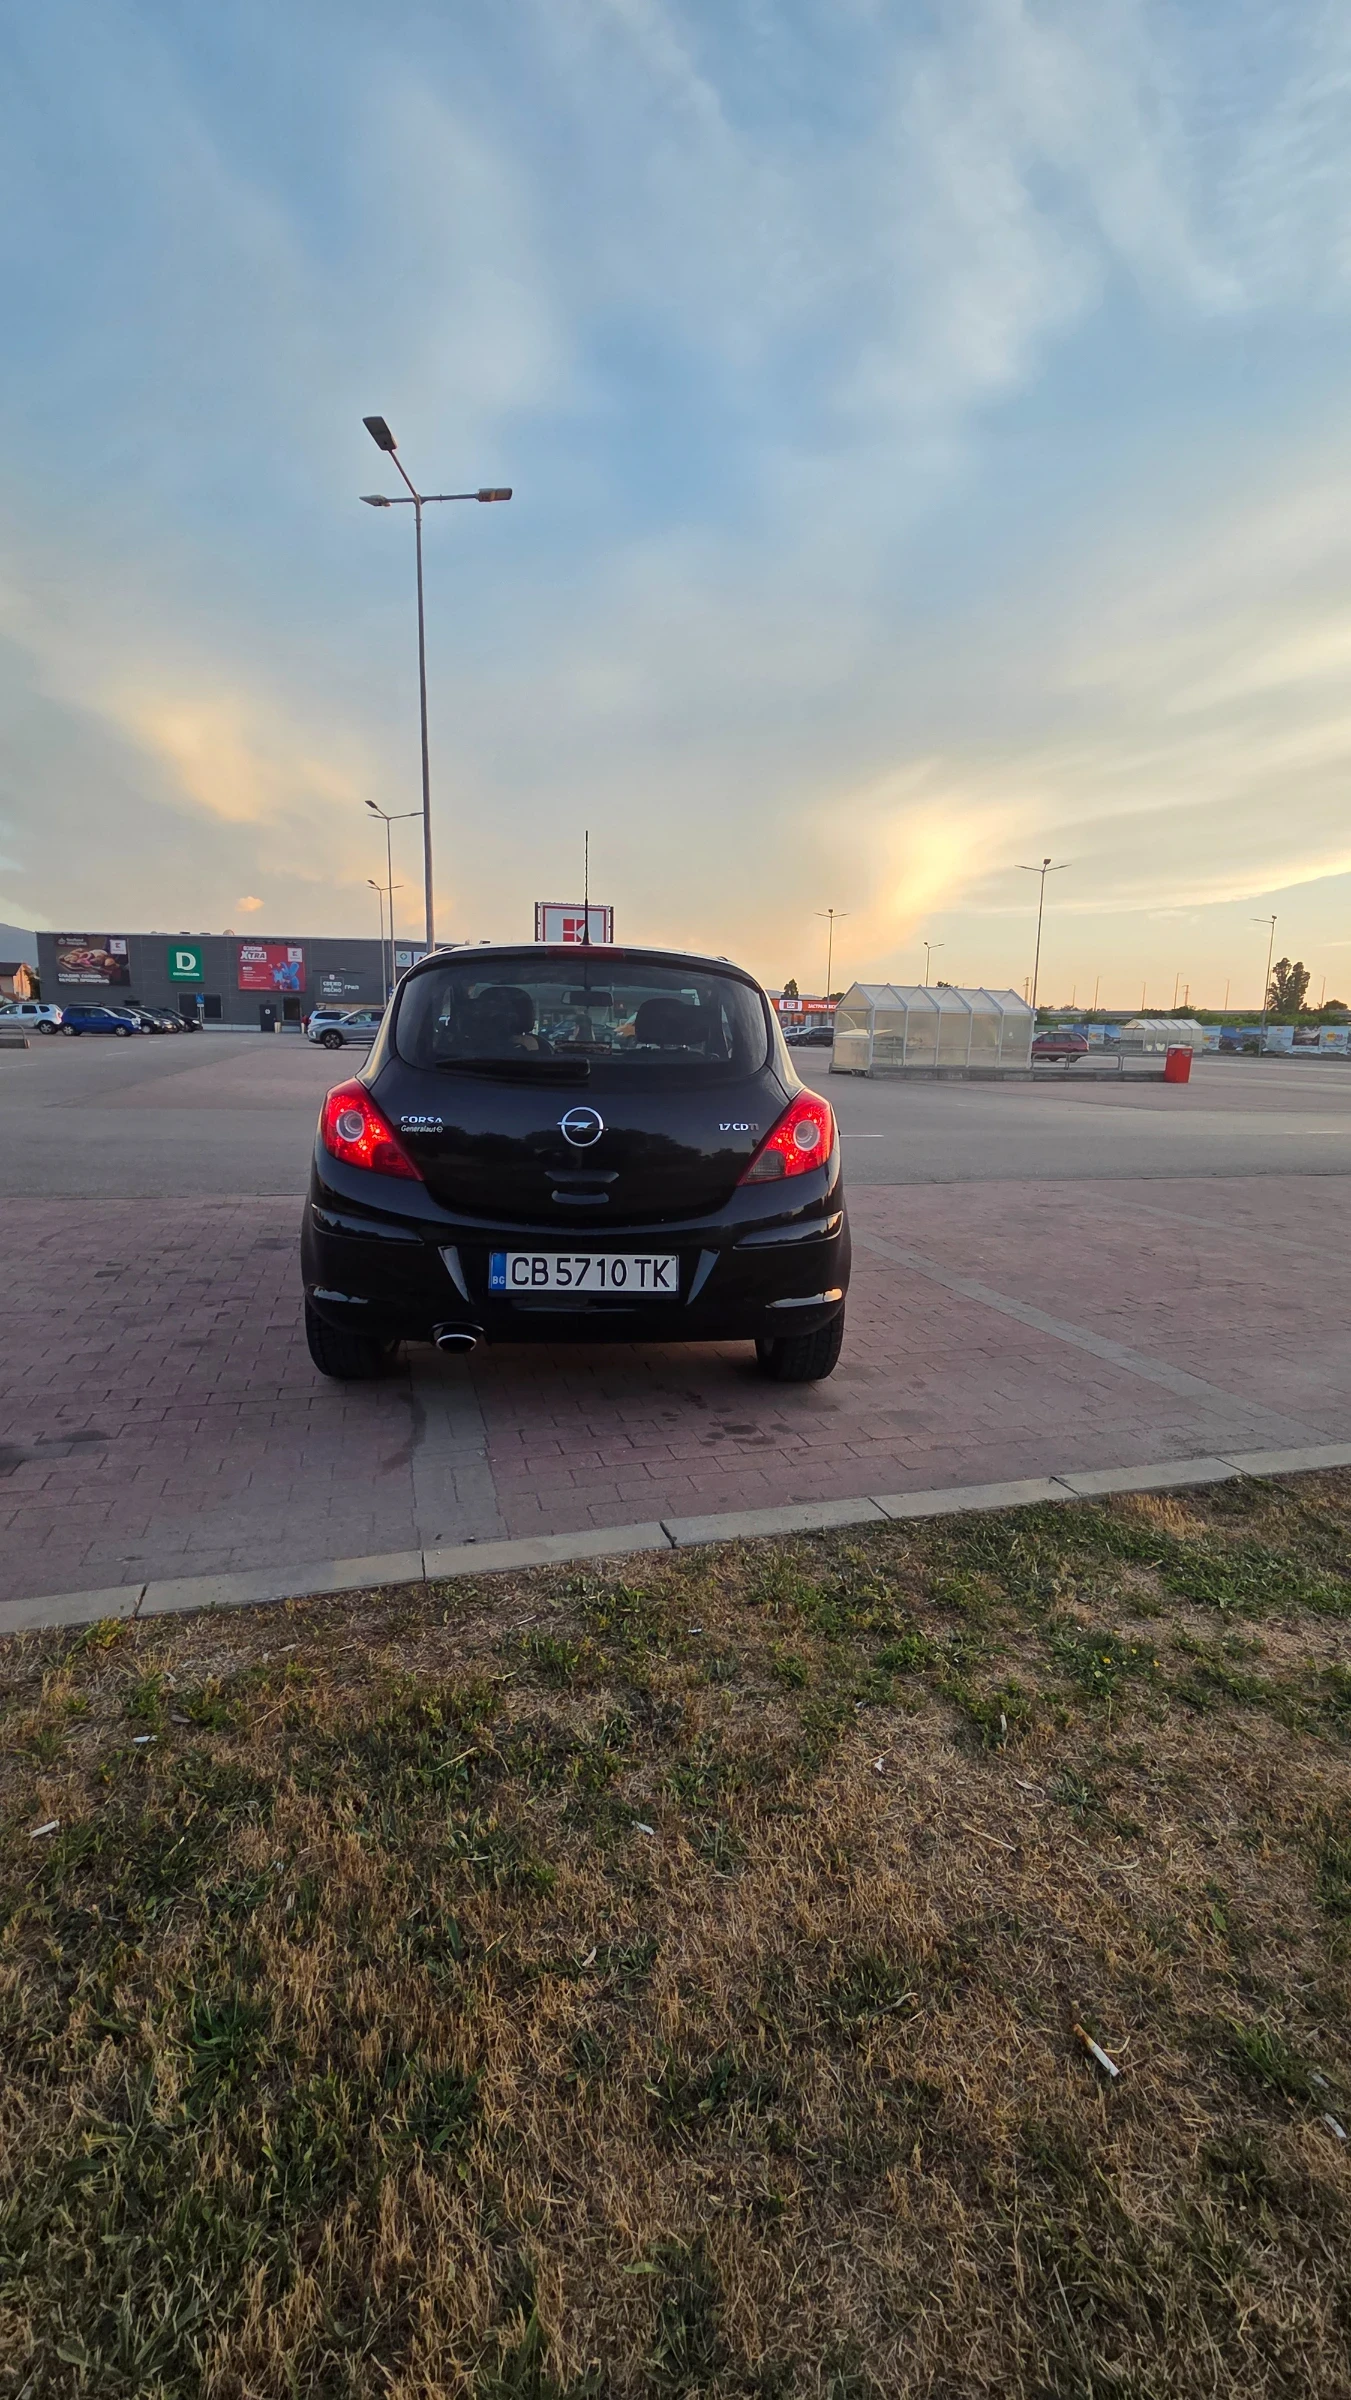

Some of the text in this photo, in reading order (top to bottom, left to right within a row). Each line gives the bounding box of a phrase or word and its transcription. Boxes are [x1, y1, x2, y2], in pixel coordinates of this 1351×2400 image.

[241, 951, 267, 960] XTRA
[176, 952, 196, 970] D
[400, 1115, 443, 1124] CORSA
[492, 1275, 505, 1285] BG
